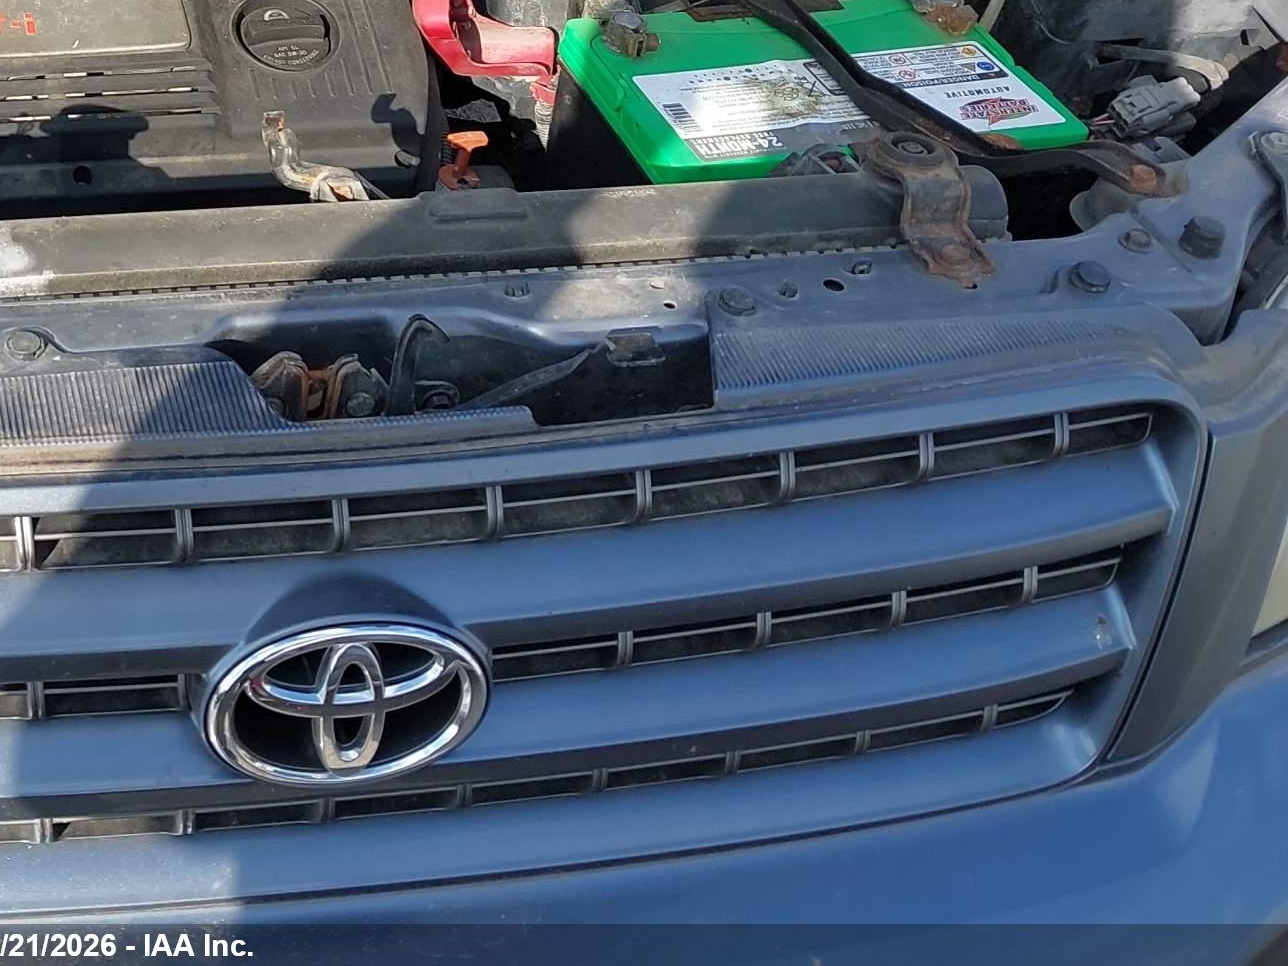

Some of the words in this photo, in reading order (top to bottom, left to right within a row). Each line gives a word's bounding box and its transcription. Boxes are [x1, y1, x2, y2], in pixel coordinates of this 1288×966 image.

[943, 85, 1011, 99] AUTOMOTIVE
[959, 98, 1030, 113] BATTERIES
[960, 104, 1038, 121] INTERSTATE
[696, 137, 784, 156] 24-MONTH
